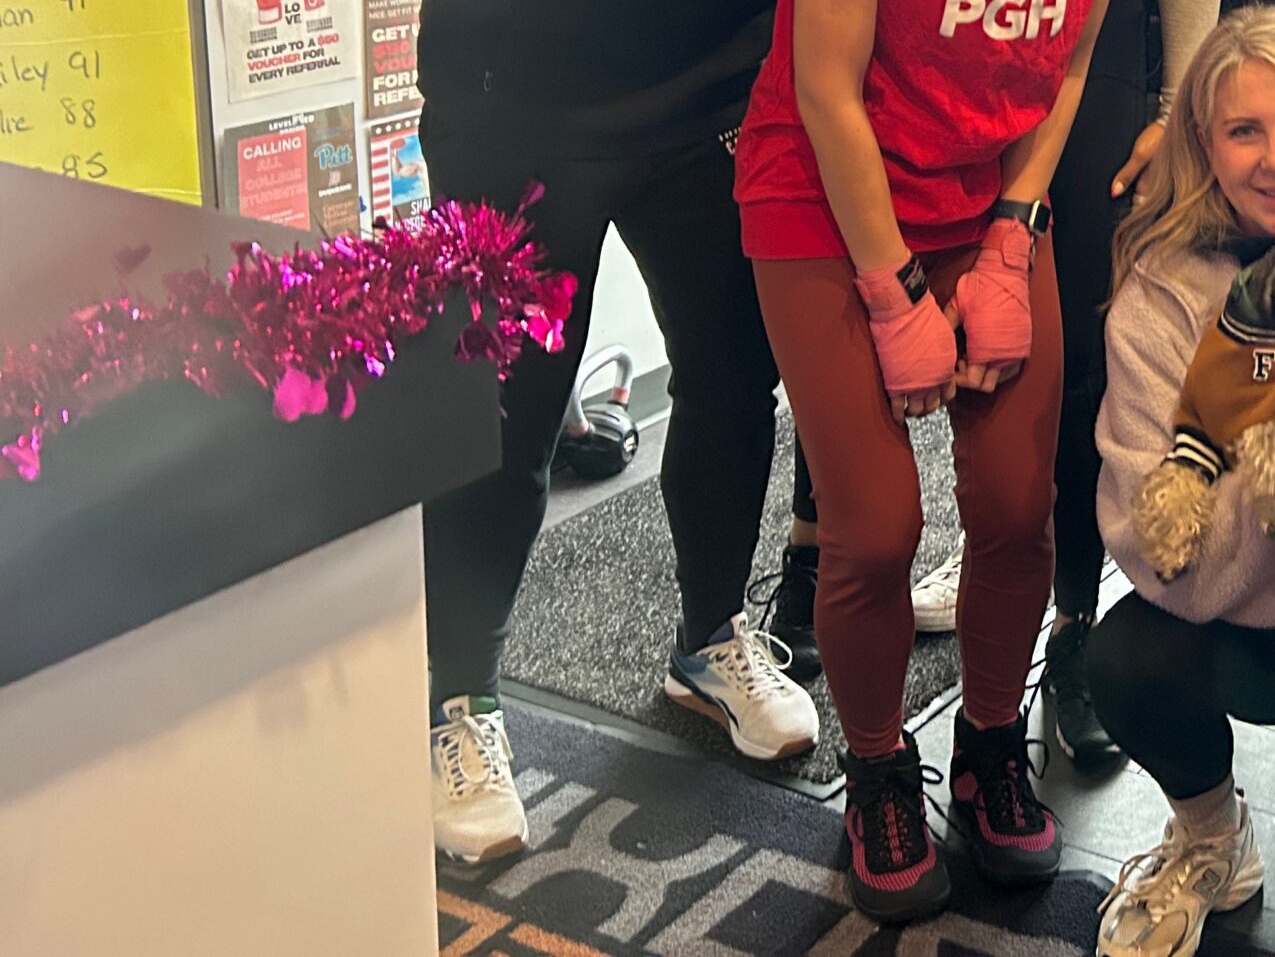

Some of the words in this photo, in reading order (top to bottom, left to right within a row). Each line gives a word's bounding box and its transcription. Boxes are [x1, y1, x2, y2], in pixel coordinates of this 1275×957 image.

[284, 2, 301, 14] LO
[285, 13, 302, 25] VE
[372, 25, 409, 43] GET
[247, 47, 270, 60] GET
[271, 44, 287, 55] UP
[288, 40, 305, 52] TO
[308, 38, 316, 48] A
[248, 53, 301, 71] VOUCHER
[303, 48, 325, 60] FOR
[68, 50, 100, 80] 91
[249, 67, 284, 83] EVERY
[286, 55, 341, 76] REFERRAL
[373, 71, 410, 91] FOR
[59, 96, 97, 129] 88
[243, 136, 302, 160] CALLING
[314, 142, 353, 170] Pitt
[256, 156, 283, 173] ALL
[245, 168, 301, 191] COLLEGE
